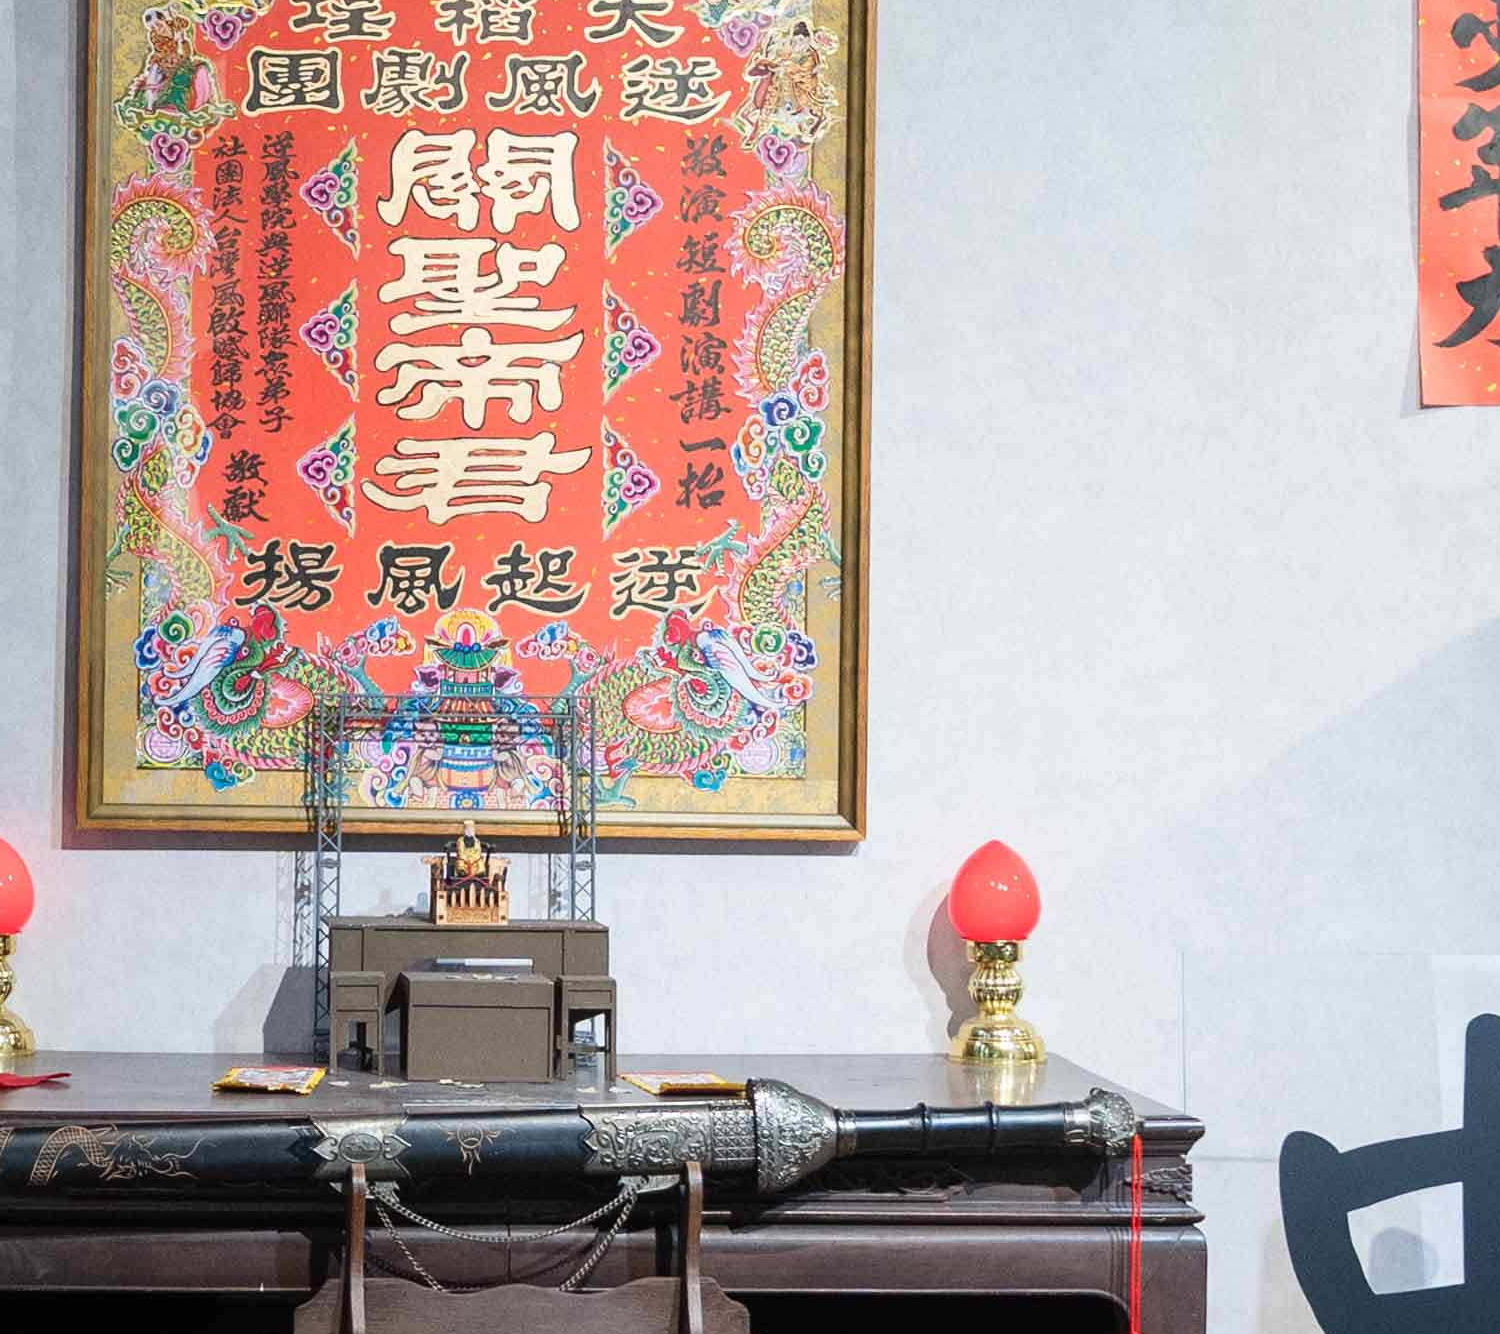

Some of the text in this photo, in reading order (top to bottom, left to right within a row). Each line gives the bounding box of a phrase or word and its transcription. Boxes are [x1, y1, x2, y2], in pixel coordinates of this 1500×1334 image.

[243, 49, 731, 123] 逆風劇團
[361, 128, 593, 525] 關聖帝君
